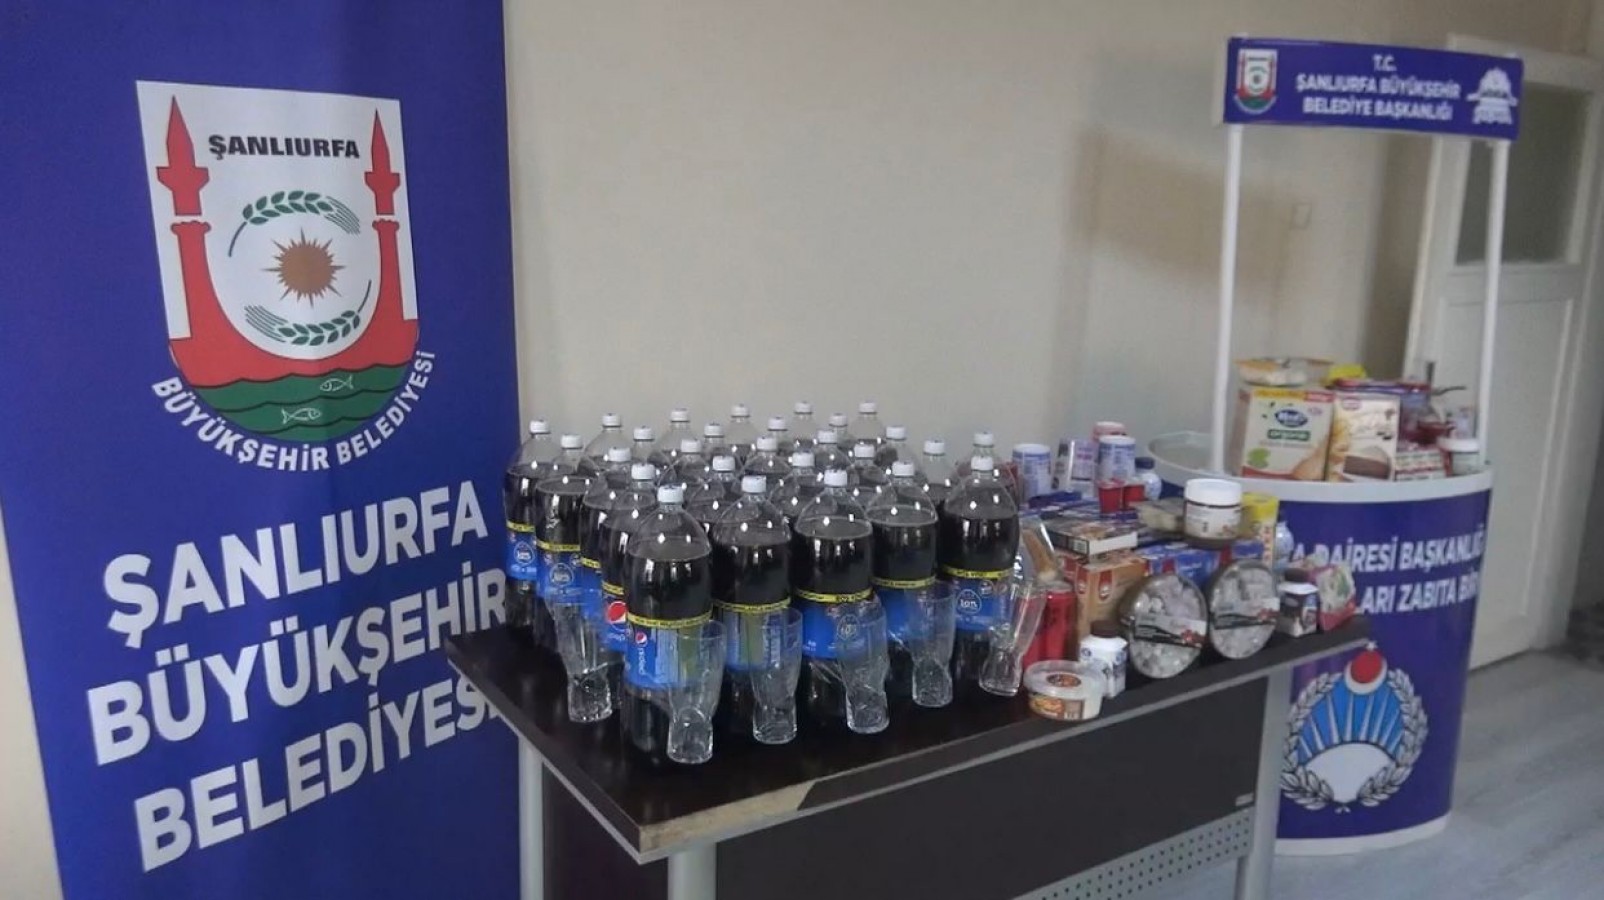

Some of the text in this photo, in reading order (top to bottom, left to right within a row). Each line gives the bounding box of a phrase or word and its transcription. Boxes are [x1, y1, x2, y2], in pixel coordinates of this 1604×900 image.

[1372, 53, 1397, 72] T.C.
[1296, 73, 1377, 93] ŞANLIURFA
[1303, 95, 1373, 116] BELEDİYE
[1374, 100, 1453, 120] BAŞKANLIĞI
[208, 134, 360, 161] ŞANLIURFA
[151, 350, 435, 471] BÜYÜKŞEHİR BELEDİYESİ
[103, 479, 489, 649] ŞANLIURFA
[1356, 585, 1395, 615] ARI
[1397, 577, 1458, 611] ZABITA
[87, 560, 506, 766] BÜYÜKŞEHİR
